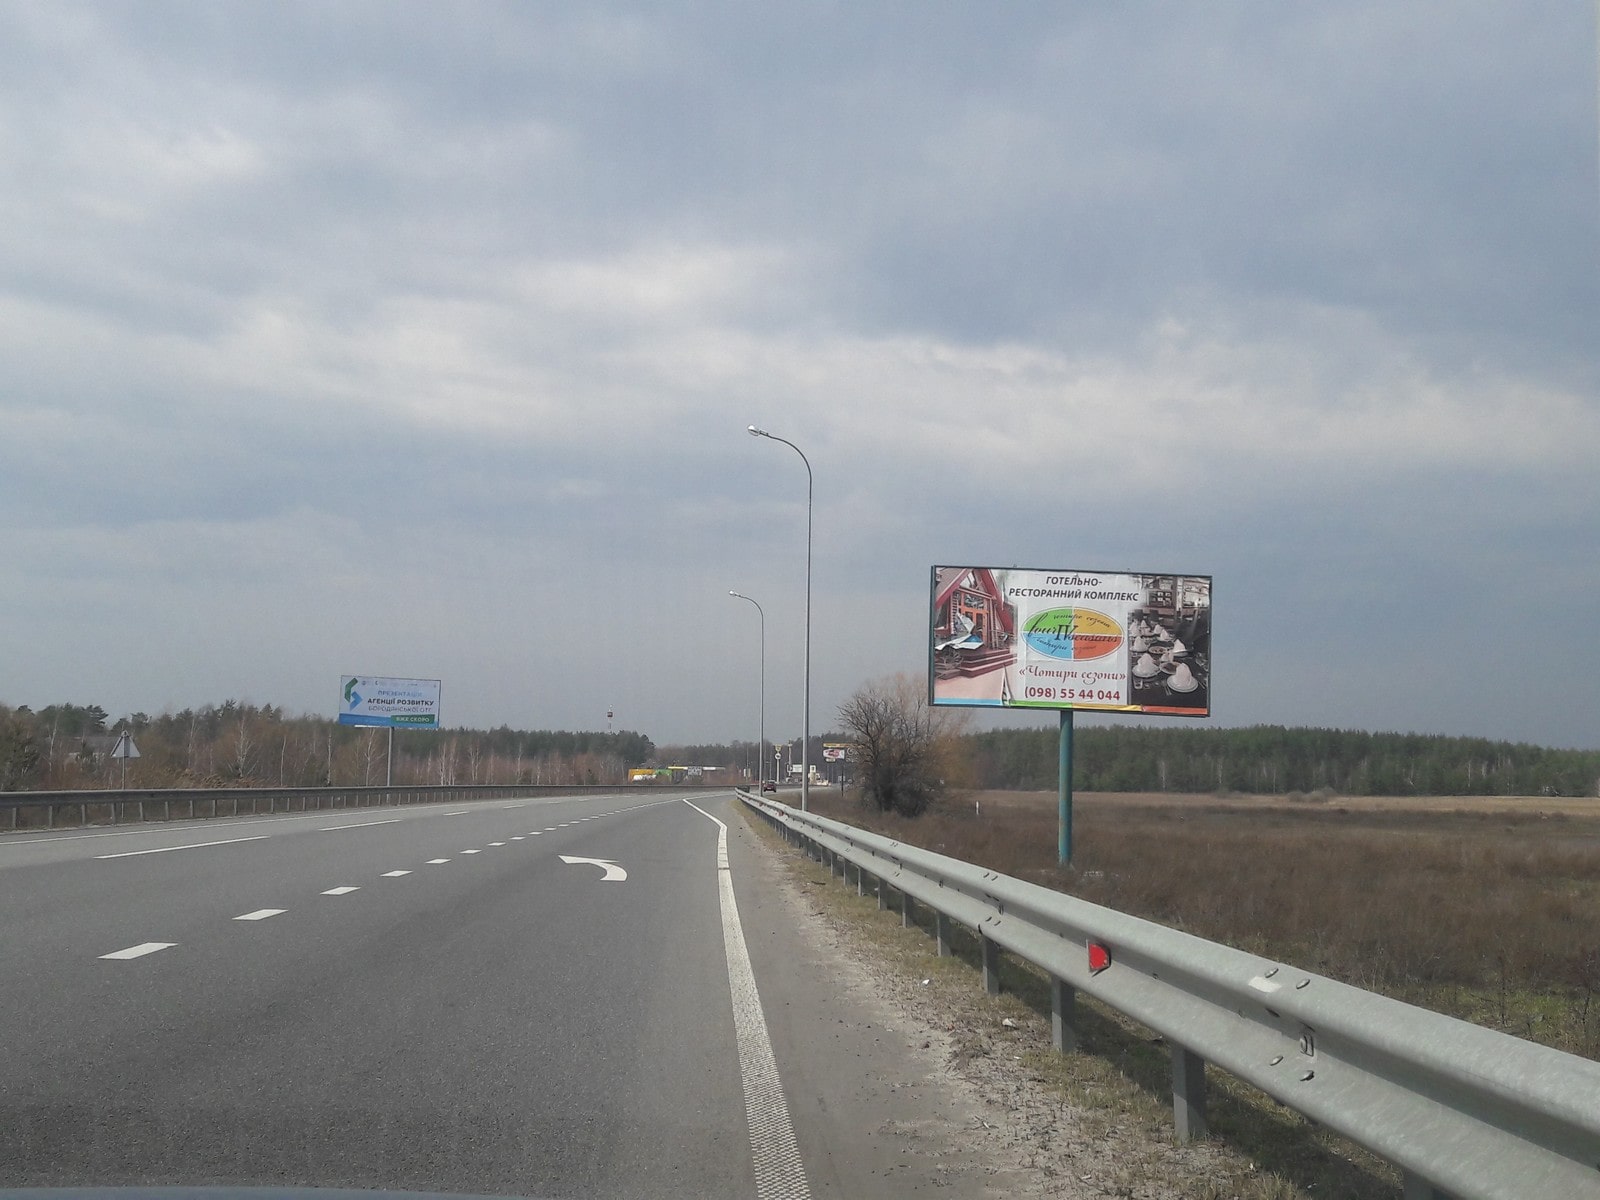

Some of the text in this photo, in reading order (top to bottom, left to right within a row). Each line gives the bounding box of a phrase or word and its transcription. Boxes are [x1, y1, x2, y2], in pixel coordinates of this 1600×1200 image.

[1046, 576, 1103, 588] ГОТЕЛЬНО-
[1008, 587, 1139, 602] РЕСТОРАННИЙ КОМПЛЕКС
[1024, 686, 1121, 701] (098) 55 44 044
